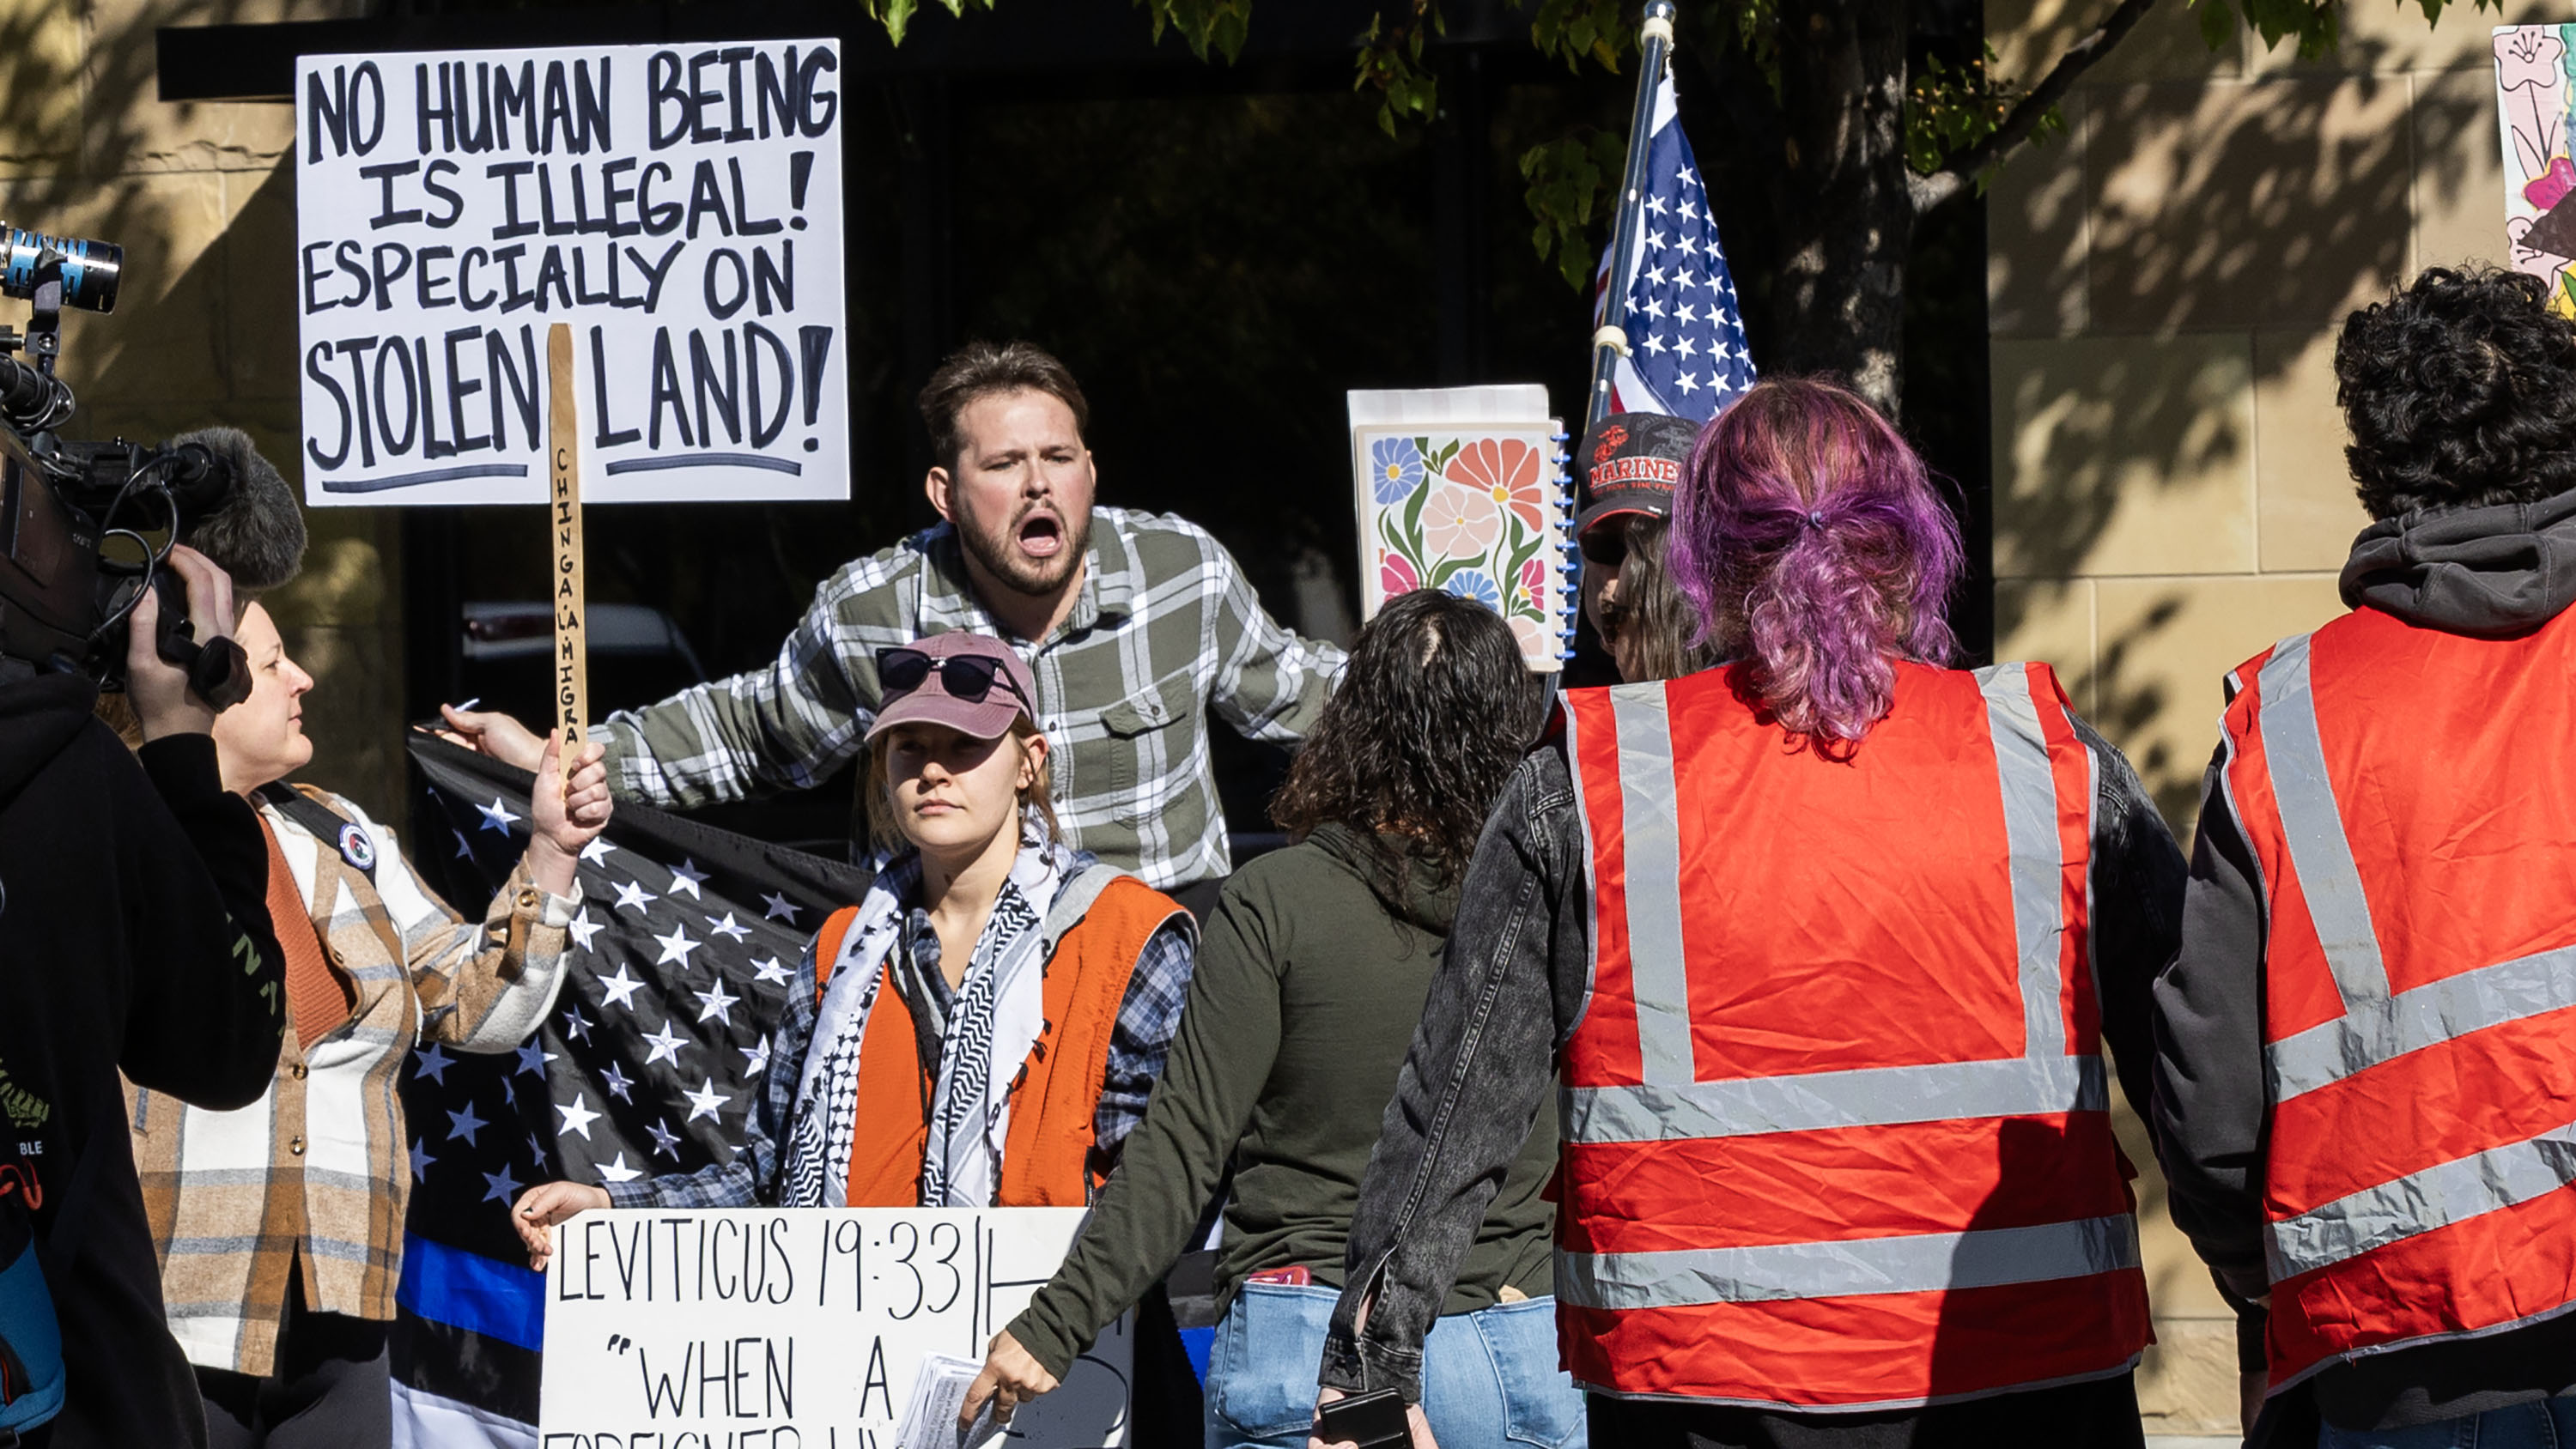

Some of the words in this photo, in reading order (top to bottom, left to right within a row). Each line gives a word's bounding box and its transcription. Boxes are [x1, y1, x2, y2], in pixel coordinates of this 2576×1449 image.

[307, 60, 385, 164] NO
[416, 56, 612, 155] HUMAN
[647, 45, 838, 150] BEING
[359, 158, 464, 230] IS
[486, 150, 815, 240] ILLEGAL!
[302, 239, 686, 314] ESPECIALLY
[703, 238, 794, 320] ON
[306, 324, 541, 471] STOLEN
[590, 321, 834, 452] LAND!
[16, 1140, 43, 1155] BLE
[559, 1217, 793, 1304] LEVITICUS
[819, 1219, 961, 1320] 19:33
[860, 1335, 894, 1421] A
